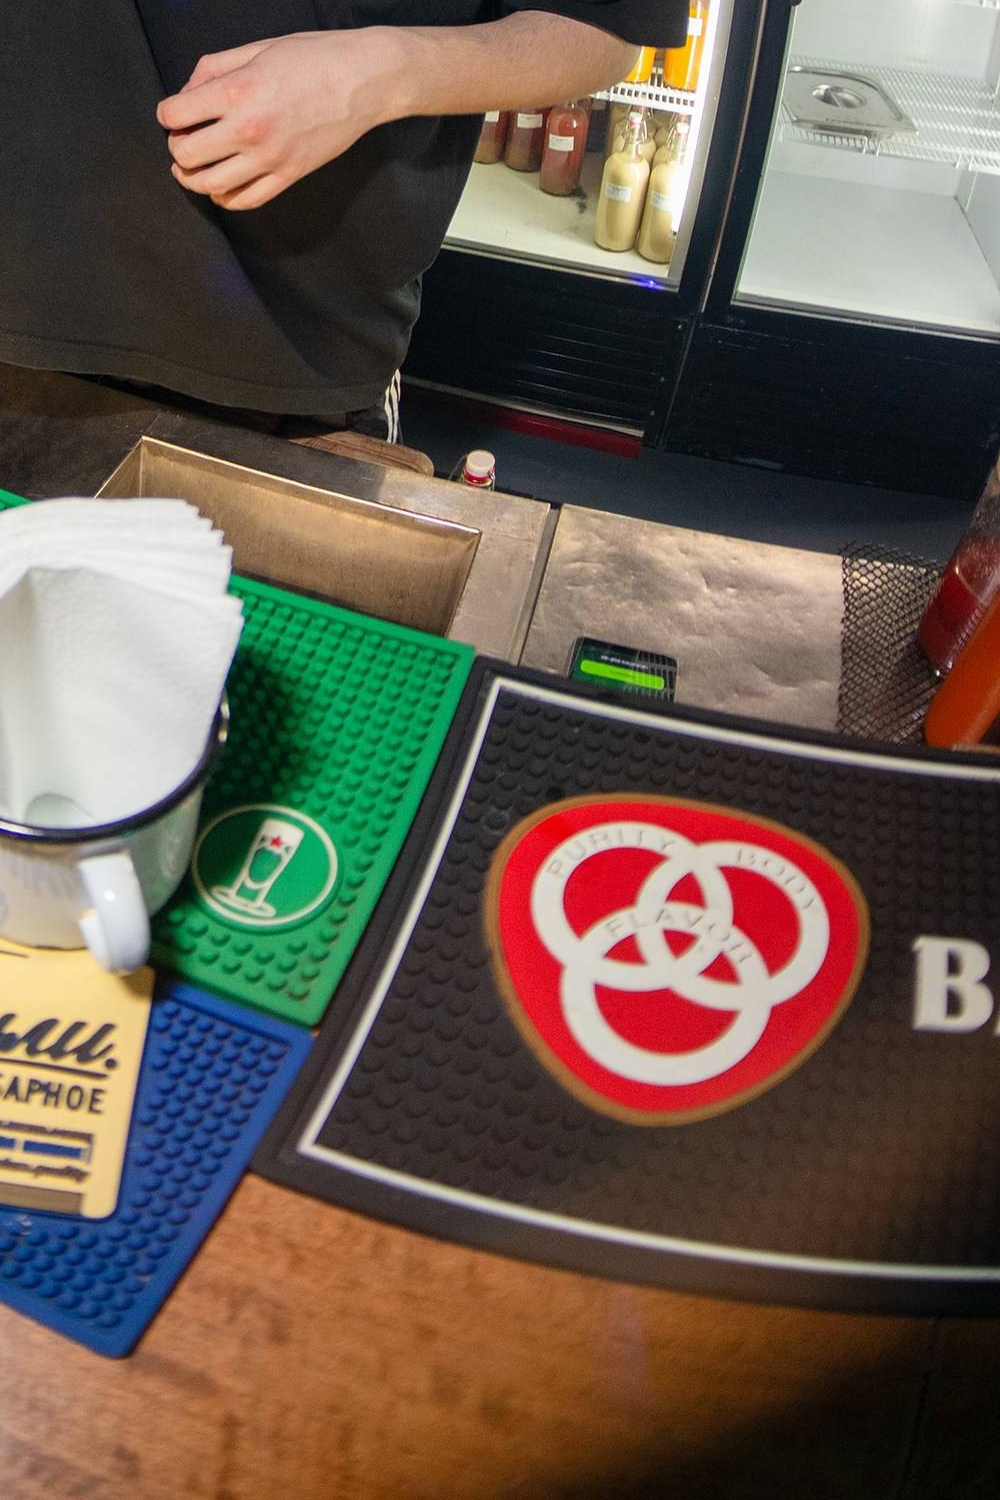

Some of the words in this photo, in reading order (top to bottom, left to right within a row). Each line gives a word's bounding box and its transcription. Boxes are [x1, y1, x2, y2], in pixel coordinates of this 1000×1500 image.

[546, 827, 678, 881] PURITY
[733, 847, 820, 913] BODY
[604, 906, 754, 965] FLAVOR
[911, 935, 1000, 1034] B
